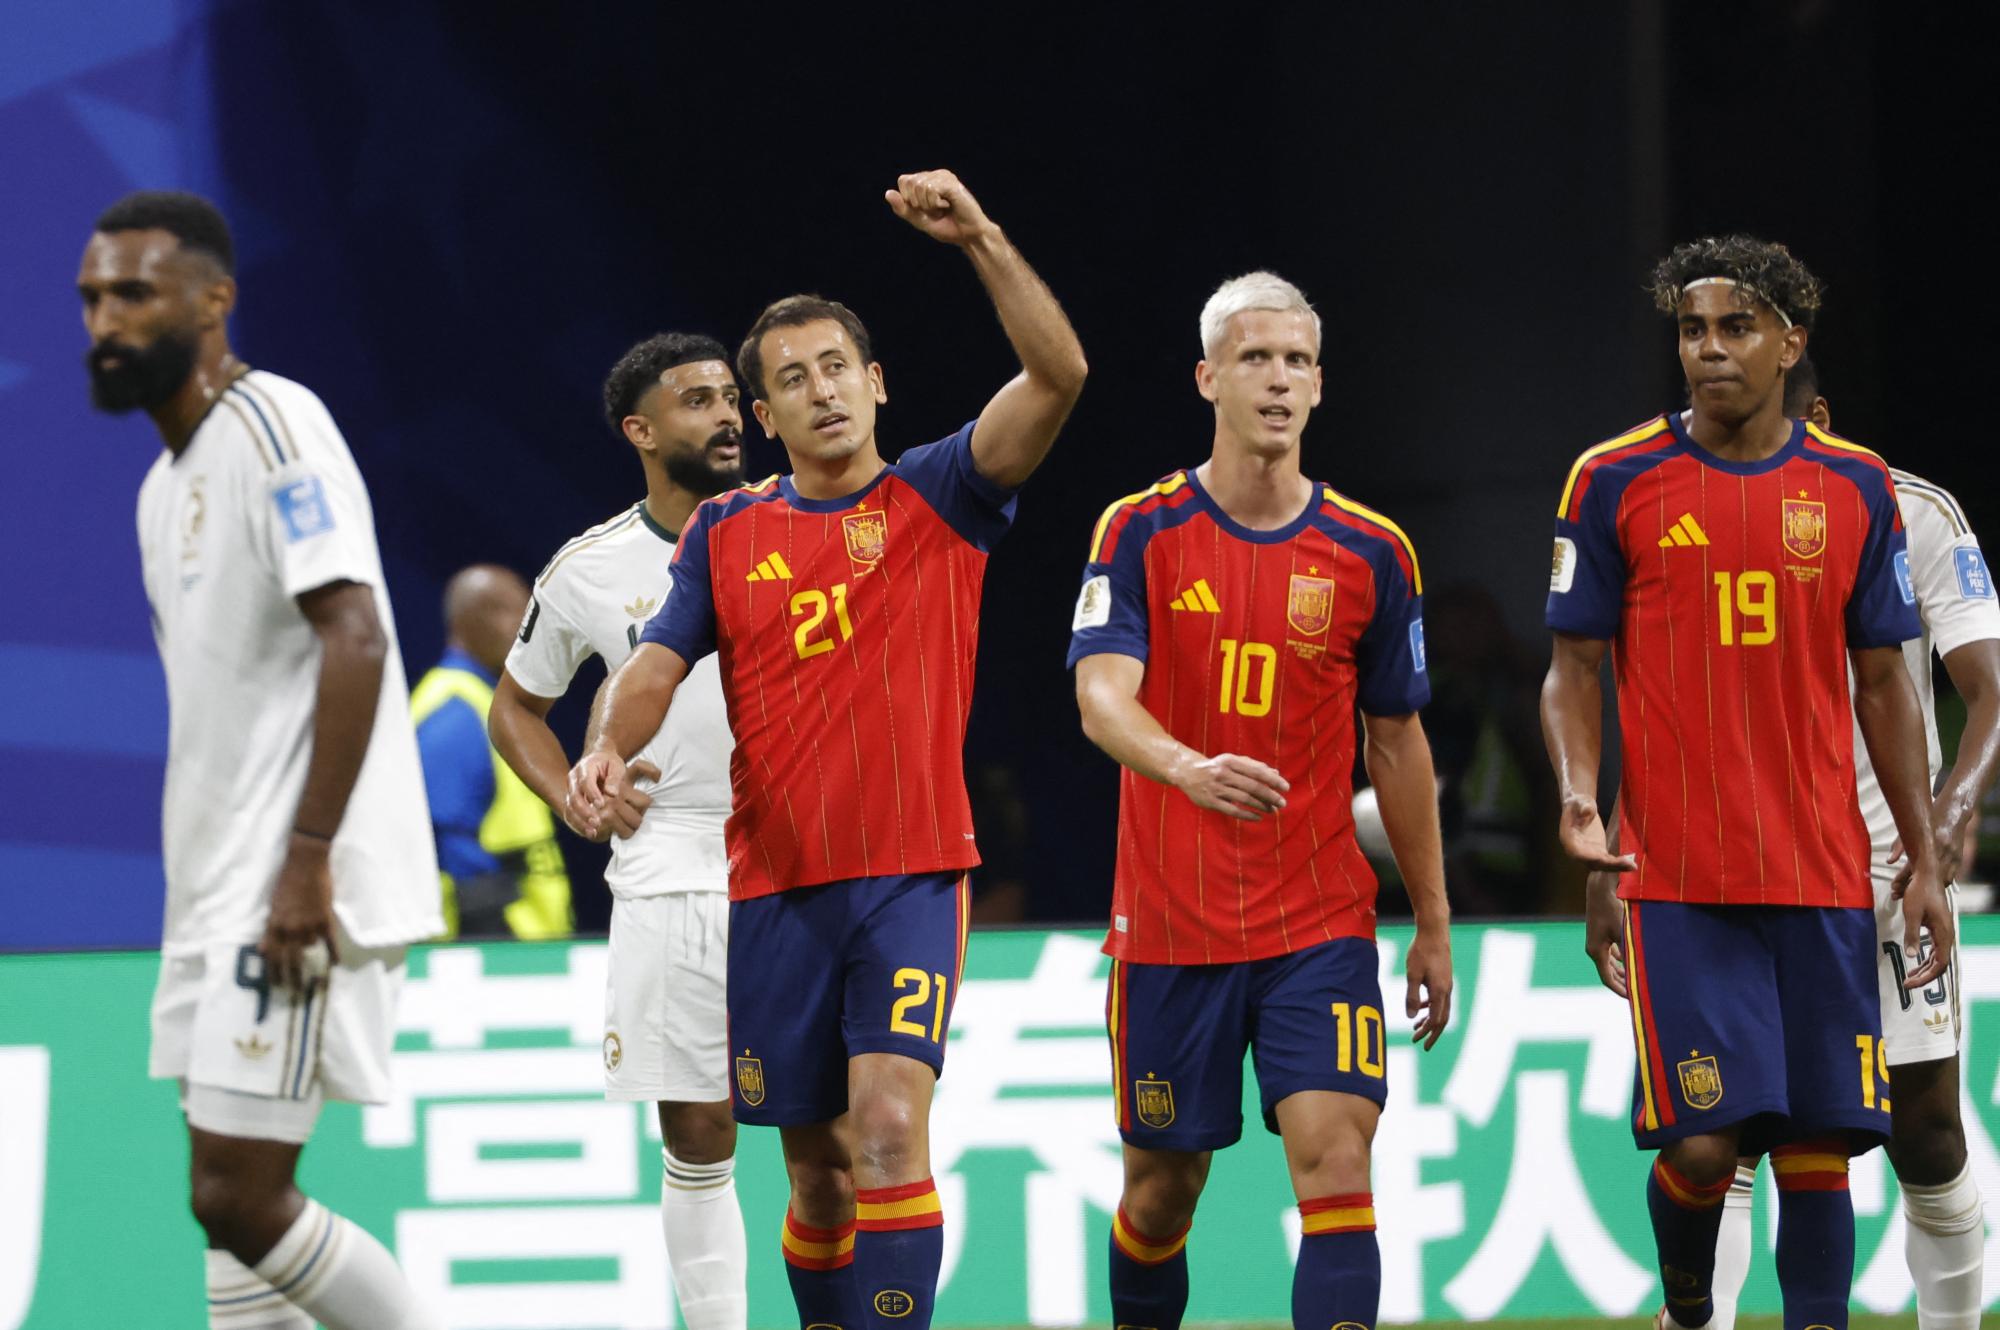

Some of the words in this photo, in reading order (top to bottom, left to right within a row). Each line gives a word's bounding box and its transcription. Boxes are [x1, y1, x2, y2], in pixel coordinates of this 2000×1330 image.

[790, 585, 852, 659] 21
[1715, 570, 1776, 646] 19
[1219, 639, 1277, 717] 10
[234, 944, 271, 1025] 9
[891, 967, 947, 1043] 21
[1331, 1003, 1384, 1079] 10
